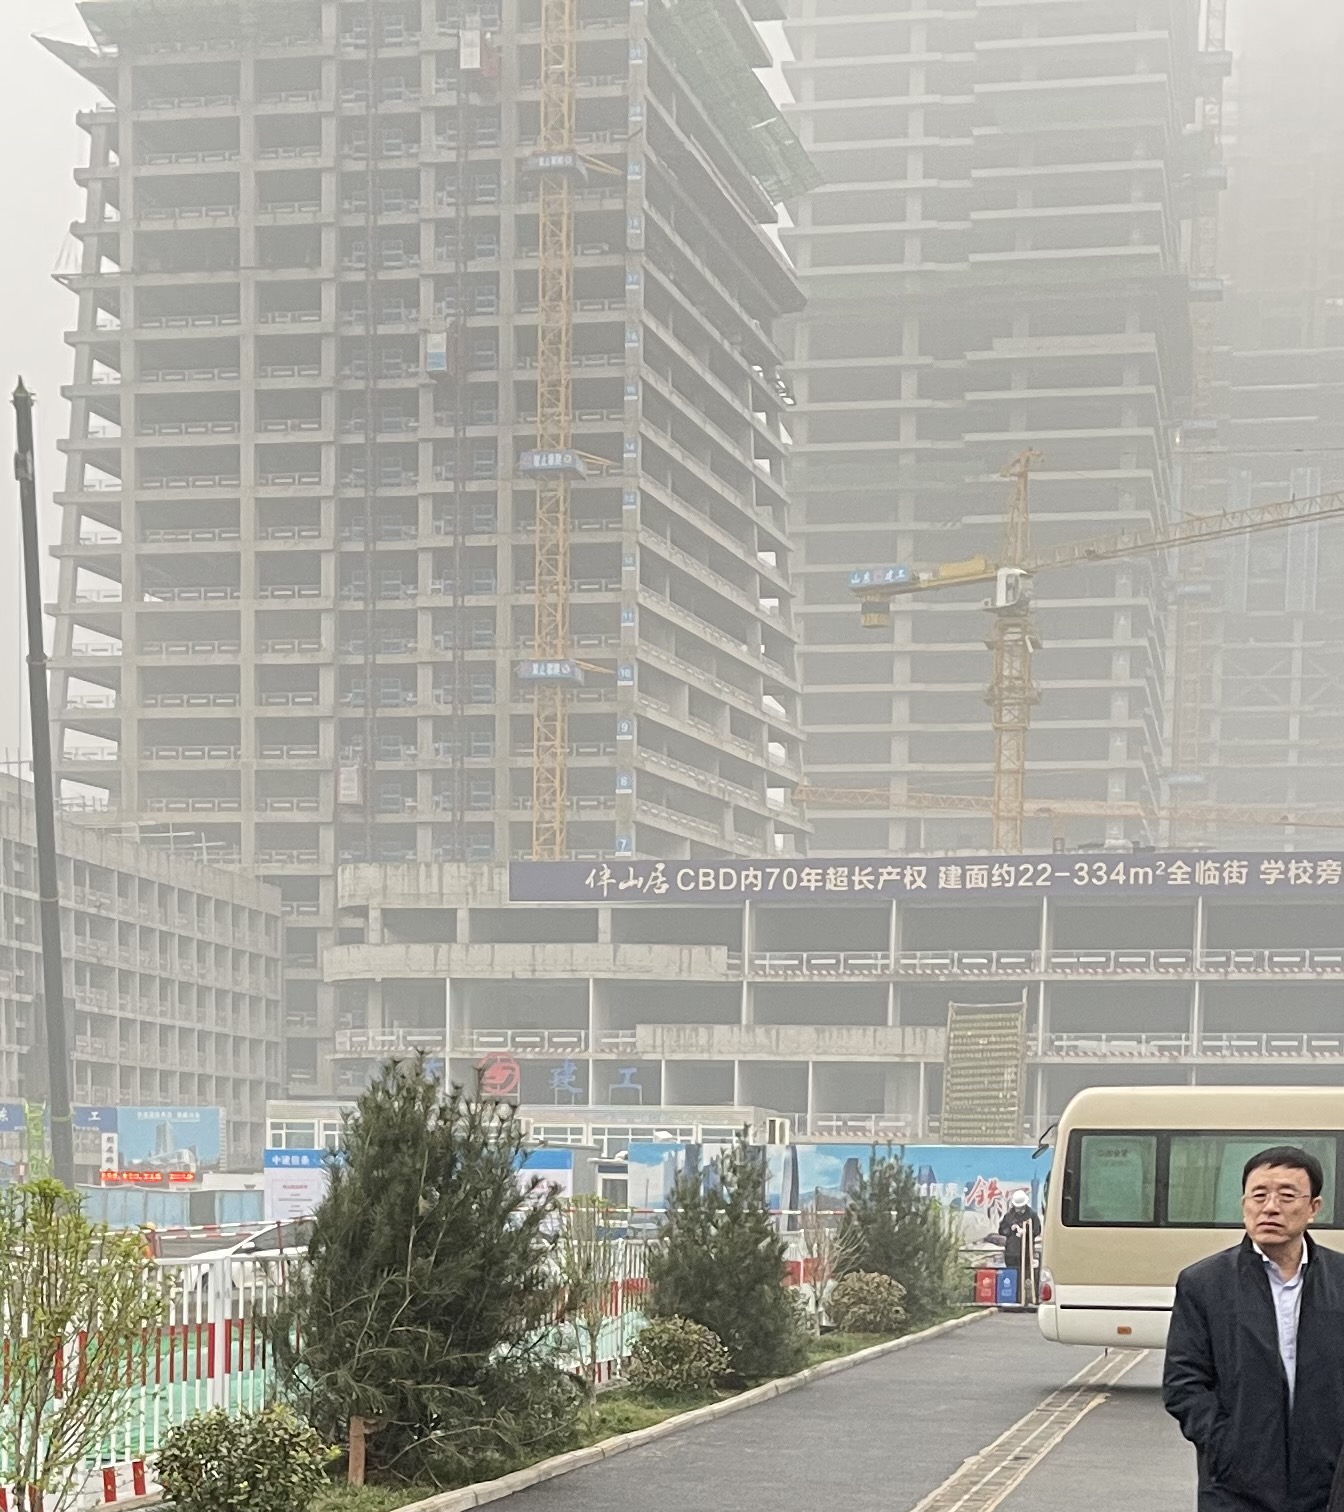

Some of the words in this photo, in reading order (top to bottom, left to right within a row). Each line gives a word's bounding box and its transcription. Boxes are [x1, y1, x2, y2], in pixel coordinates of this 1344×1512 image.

[676, 866, 927, 892] CBD内70年超长产权
